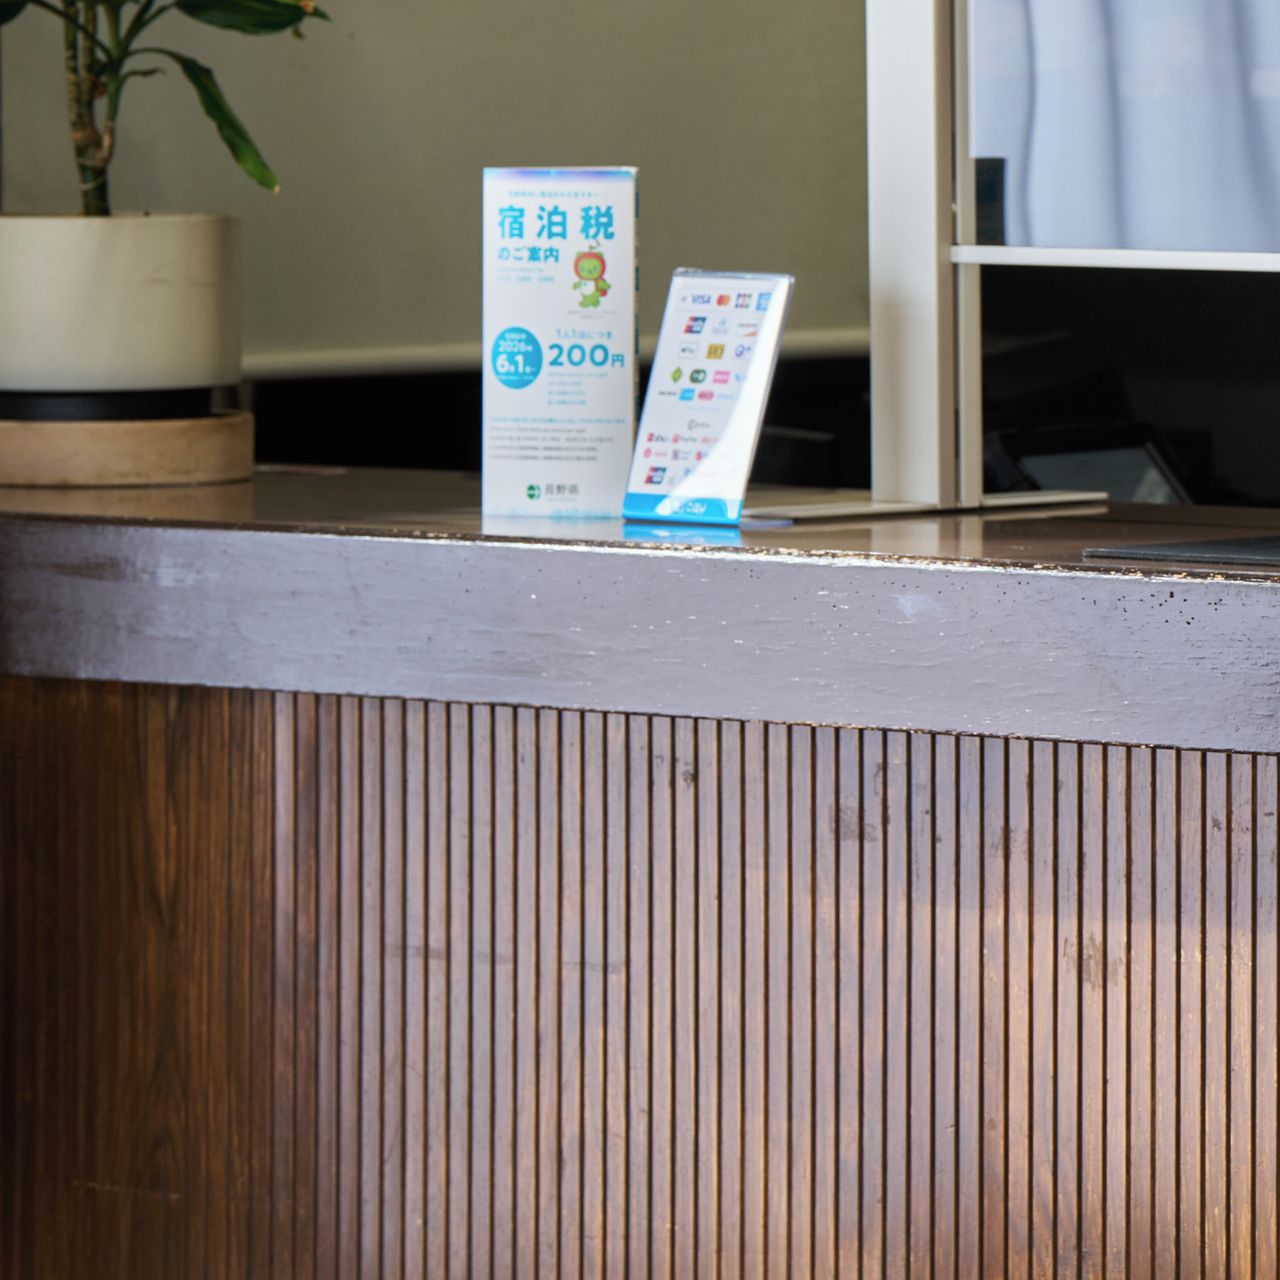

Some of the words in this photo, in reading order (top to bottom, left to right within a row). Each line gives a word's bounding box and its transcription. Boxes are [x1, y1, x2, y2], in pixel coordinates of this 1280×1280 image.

[498, 205, 615, 240] 宿泊税
[498, 246, 559, 263] のご案内
[548, 343, 625, 368] 200円
